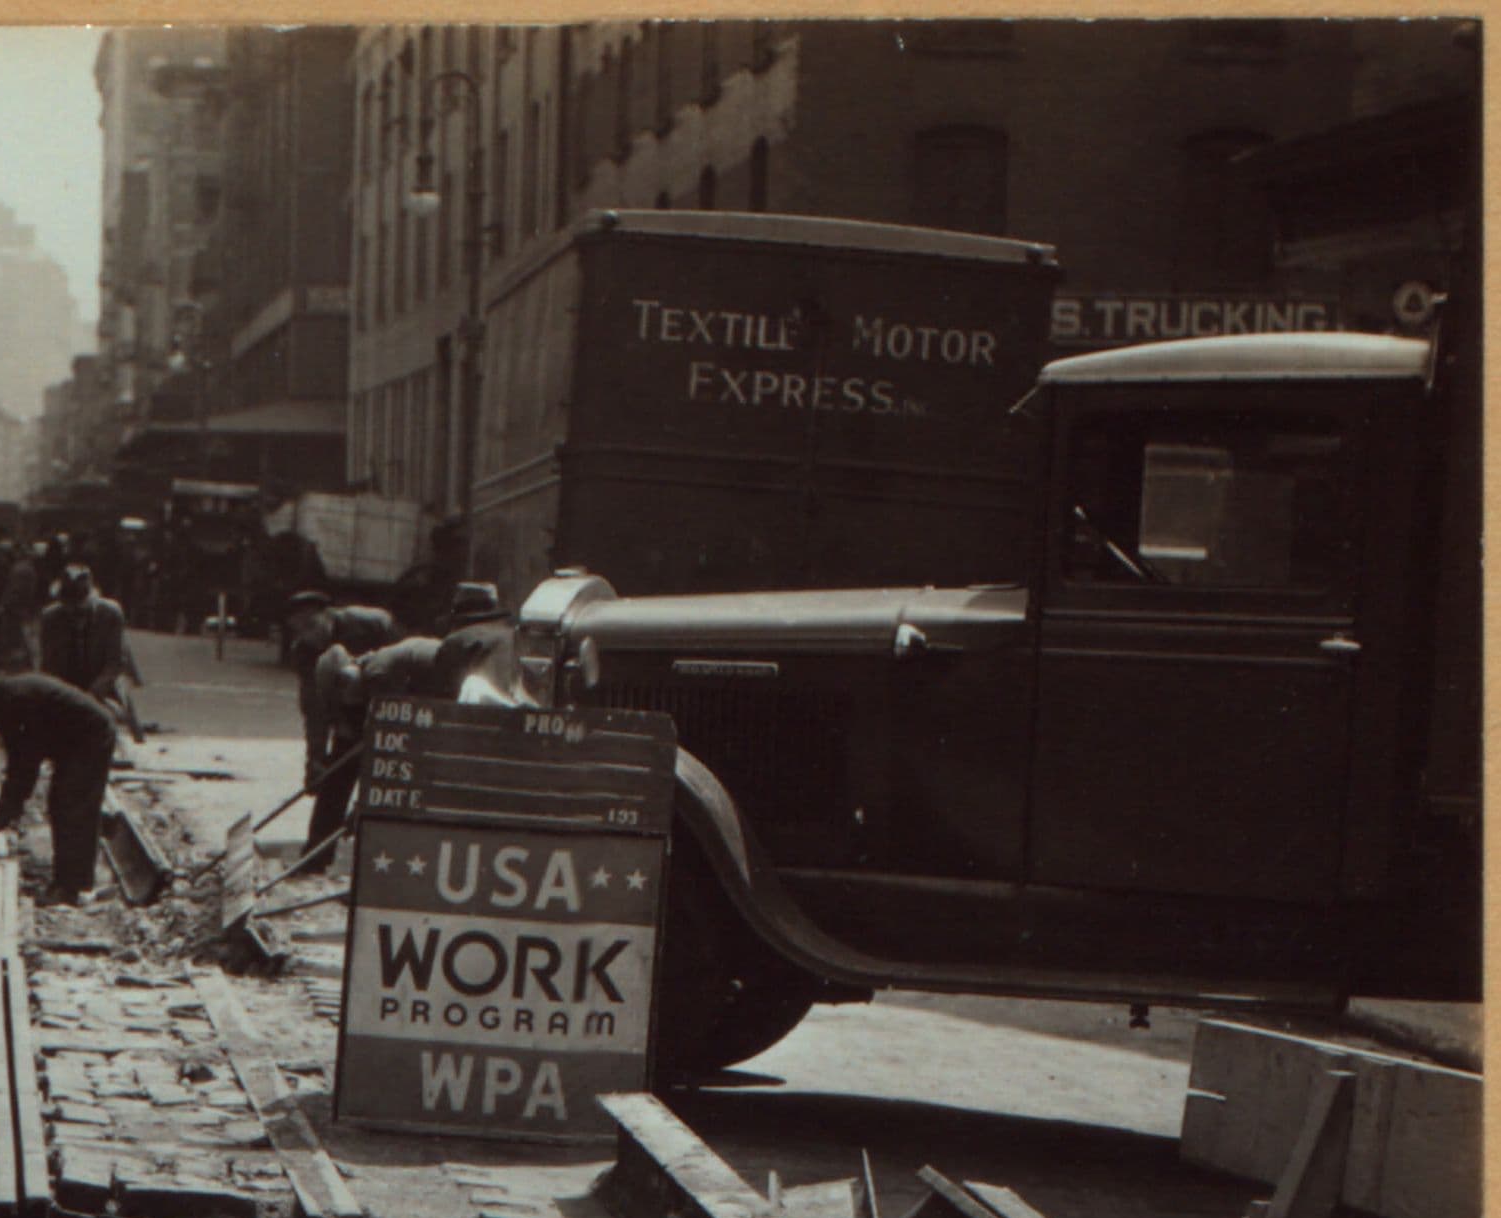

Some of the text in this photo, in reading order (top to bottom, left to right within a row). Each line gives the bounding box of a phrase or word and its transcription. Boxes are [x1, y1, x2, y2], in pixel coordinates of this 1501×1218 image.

[851, 312, 999, 368] MOTOR
[437, 840, 584, 914] USA
[378, 924, 629, 1003] WORK
[379, 998, 616, 1036] PROGRAM
[419, 1048, 570, 1122] WPA
